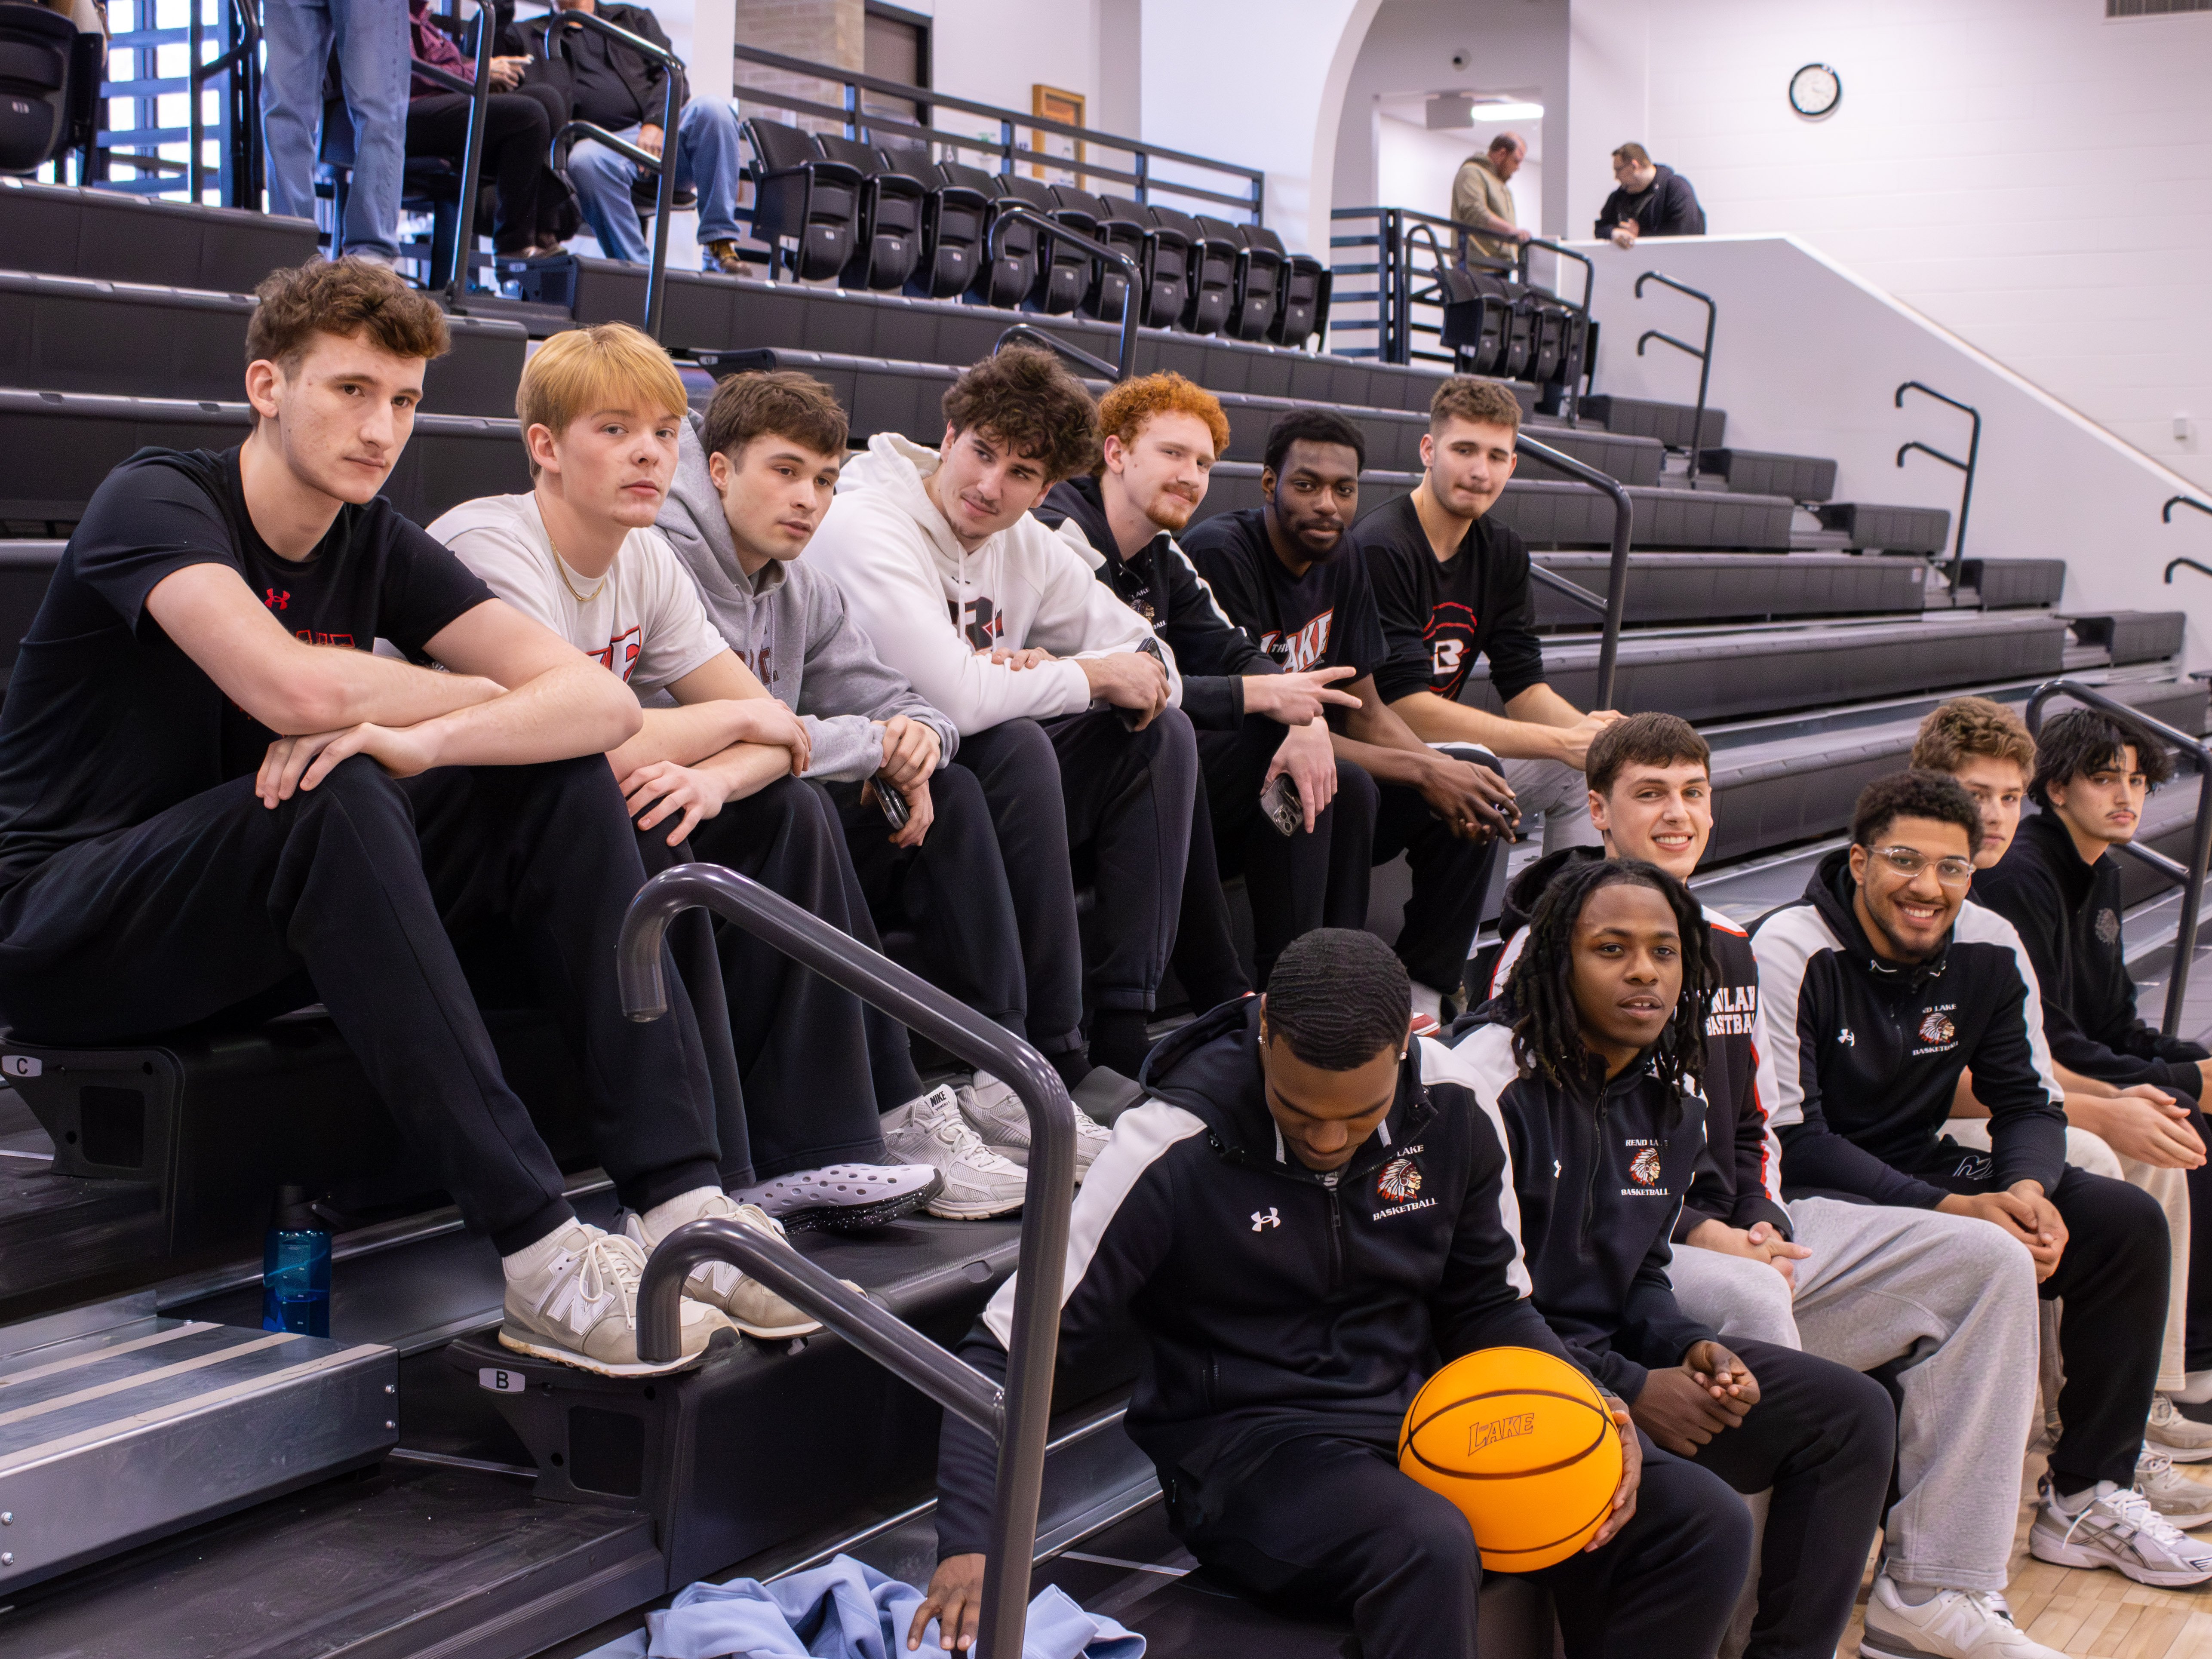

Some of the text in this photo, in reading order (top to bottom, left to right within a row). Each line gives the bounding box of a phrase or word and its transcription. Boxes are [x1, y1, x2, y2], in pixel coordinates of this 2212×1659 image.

[17, 1058, 28, 1075] C
[930, 1091, 946, 1107] NIKE
[1397, 1145, 1424, 1157] LAKE
[1621, 1188, 1671, 1196] BASKETBALL
[1373, 1198, 1438, 1221] BASKETBALL
[496, 1370, 509, 1389] B
[1468, 1413, 1534, 1456] LAKE
